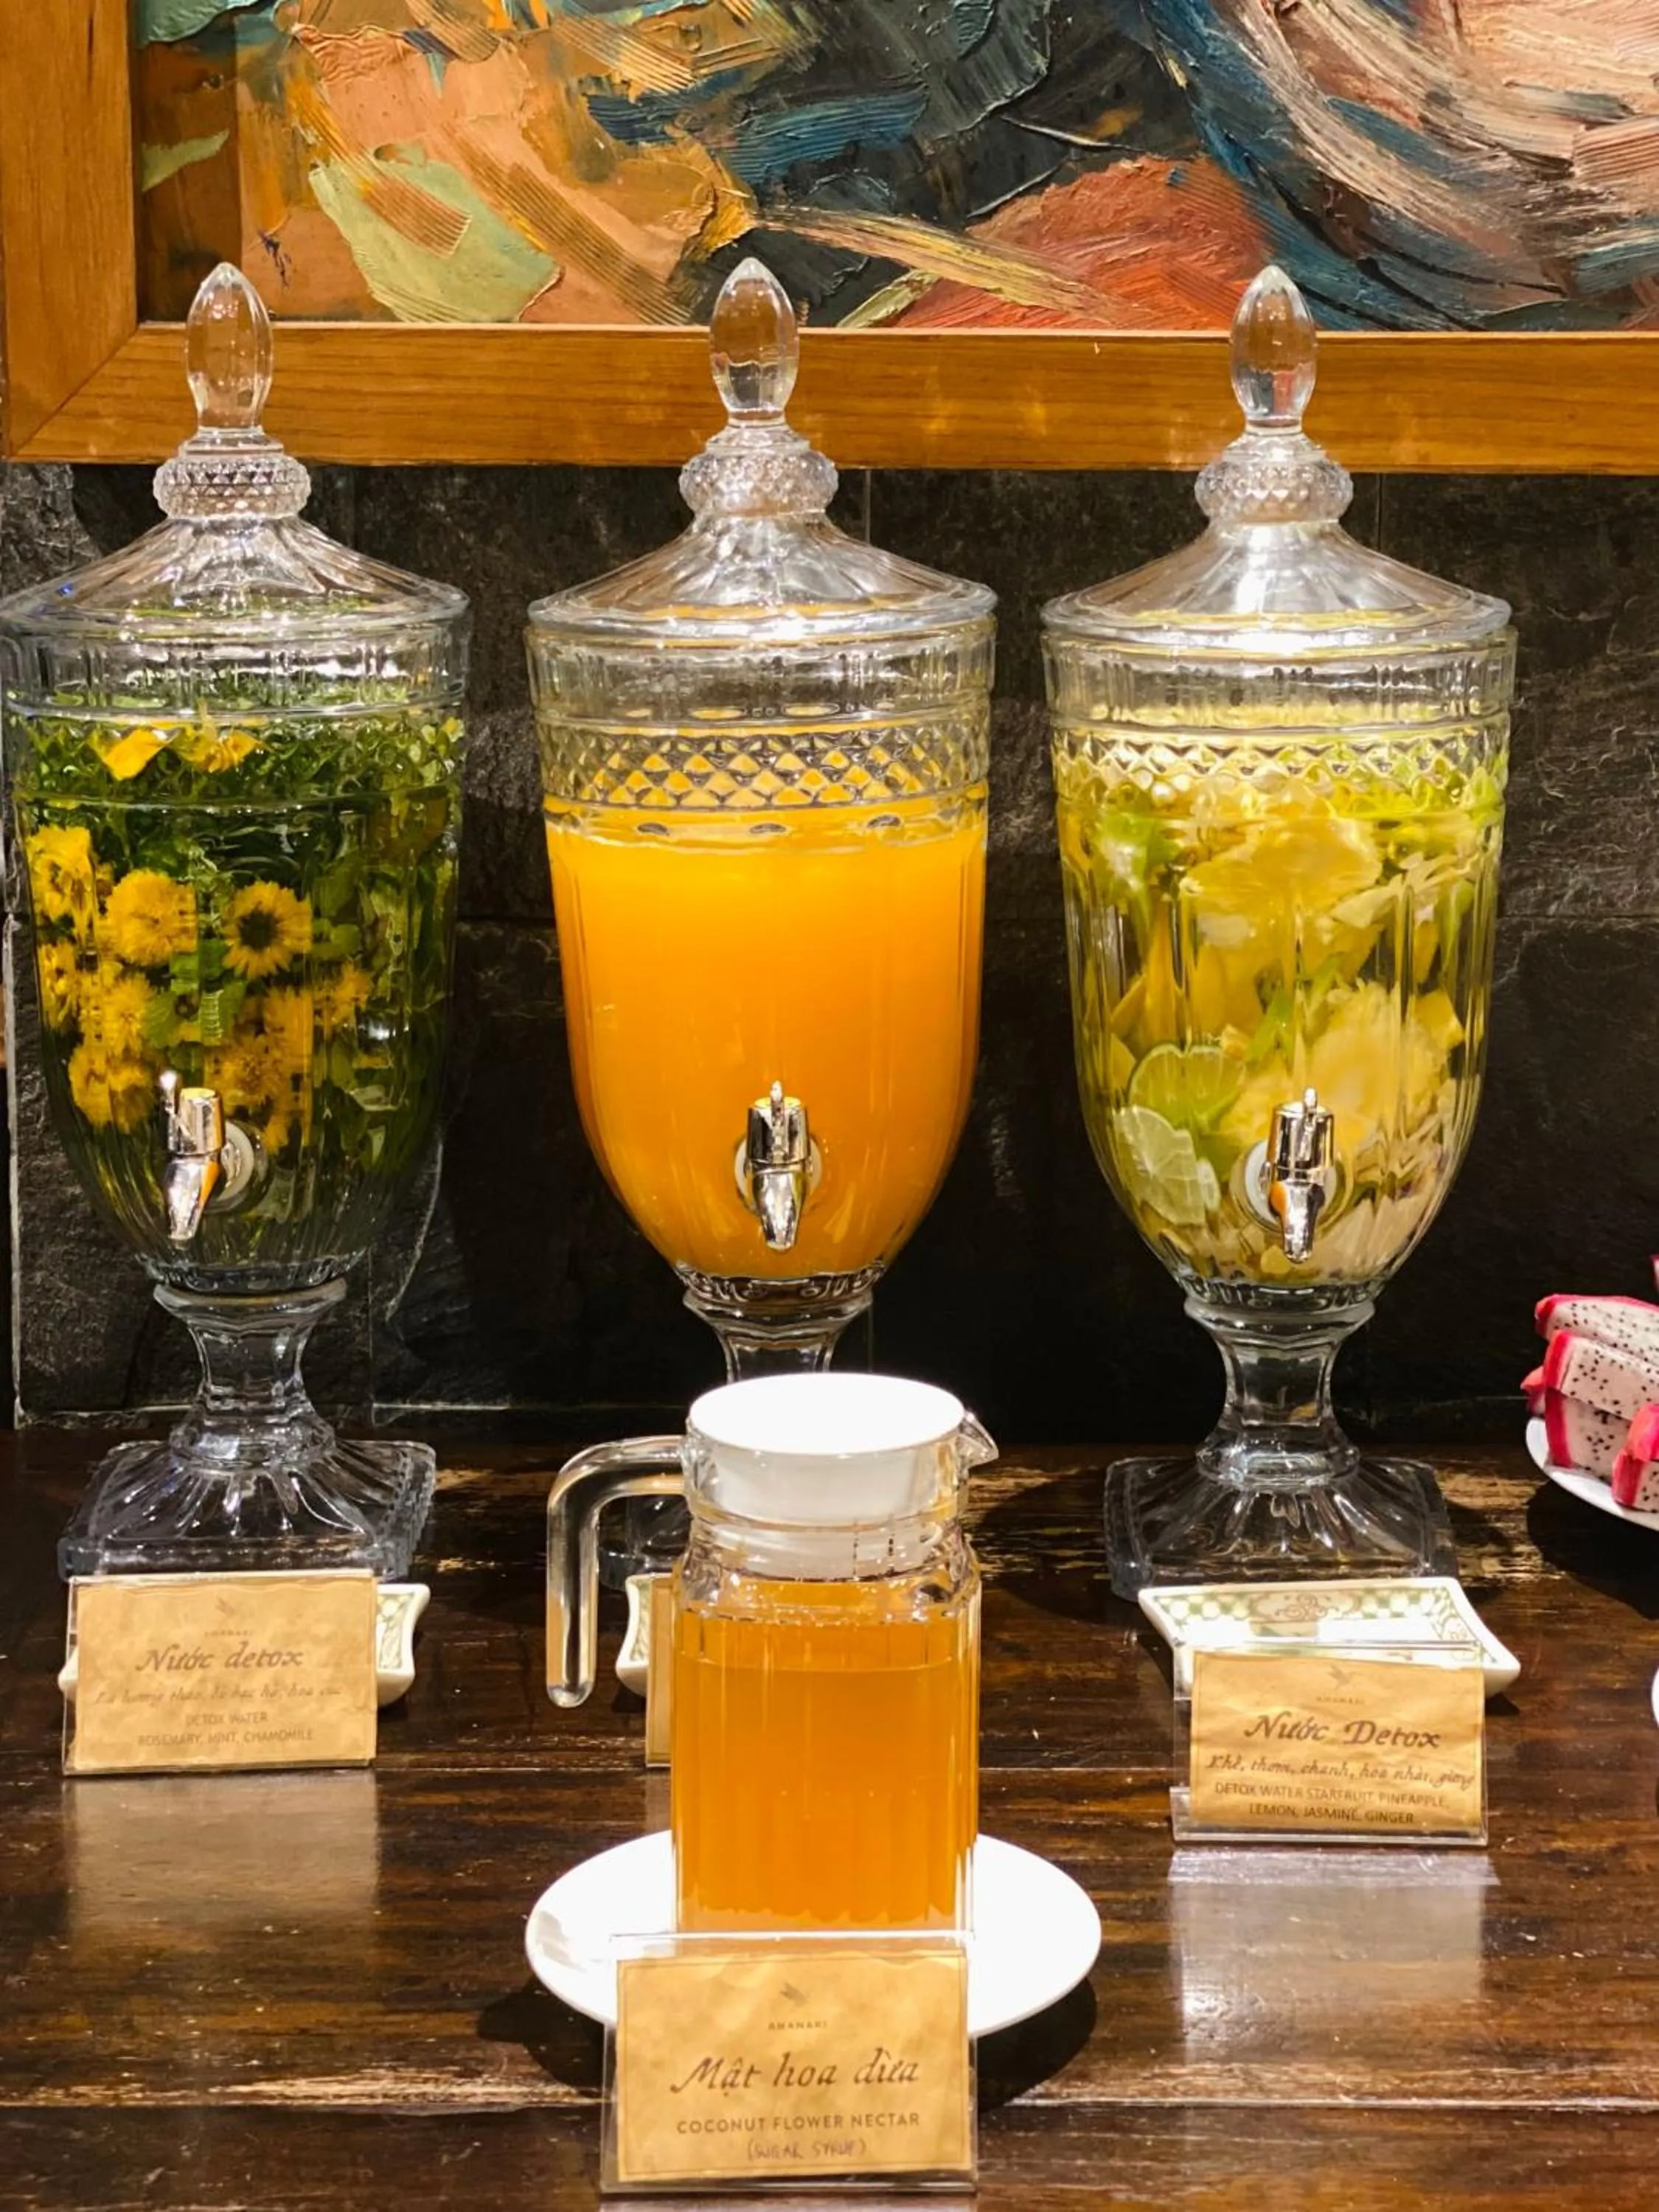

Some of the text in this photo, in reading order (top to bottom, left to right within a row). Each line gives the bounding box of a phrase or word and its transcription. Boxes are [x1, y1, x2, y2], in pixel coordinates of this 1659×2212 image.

[224, 1640, 304, 1669] detox
[186, 1711, 268, 1727] DETOX WATER
[1343, 1719, 1441, 1749] Detox
[1214, 1781, 1256, 1796] DETOX
[1259, 1784, 1304, 1799] WATER
[1364, 1810, 1414, 1825] GINGER
[669, 2054, 762, 2097] Mật
[773, 2051, 838, 2088] hoa
[675, 2112, 920, 2135] COCONUT FLOWER NECTAR
